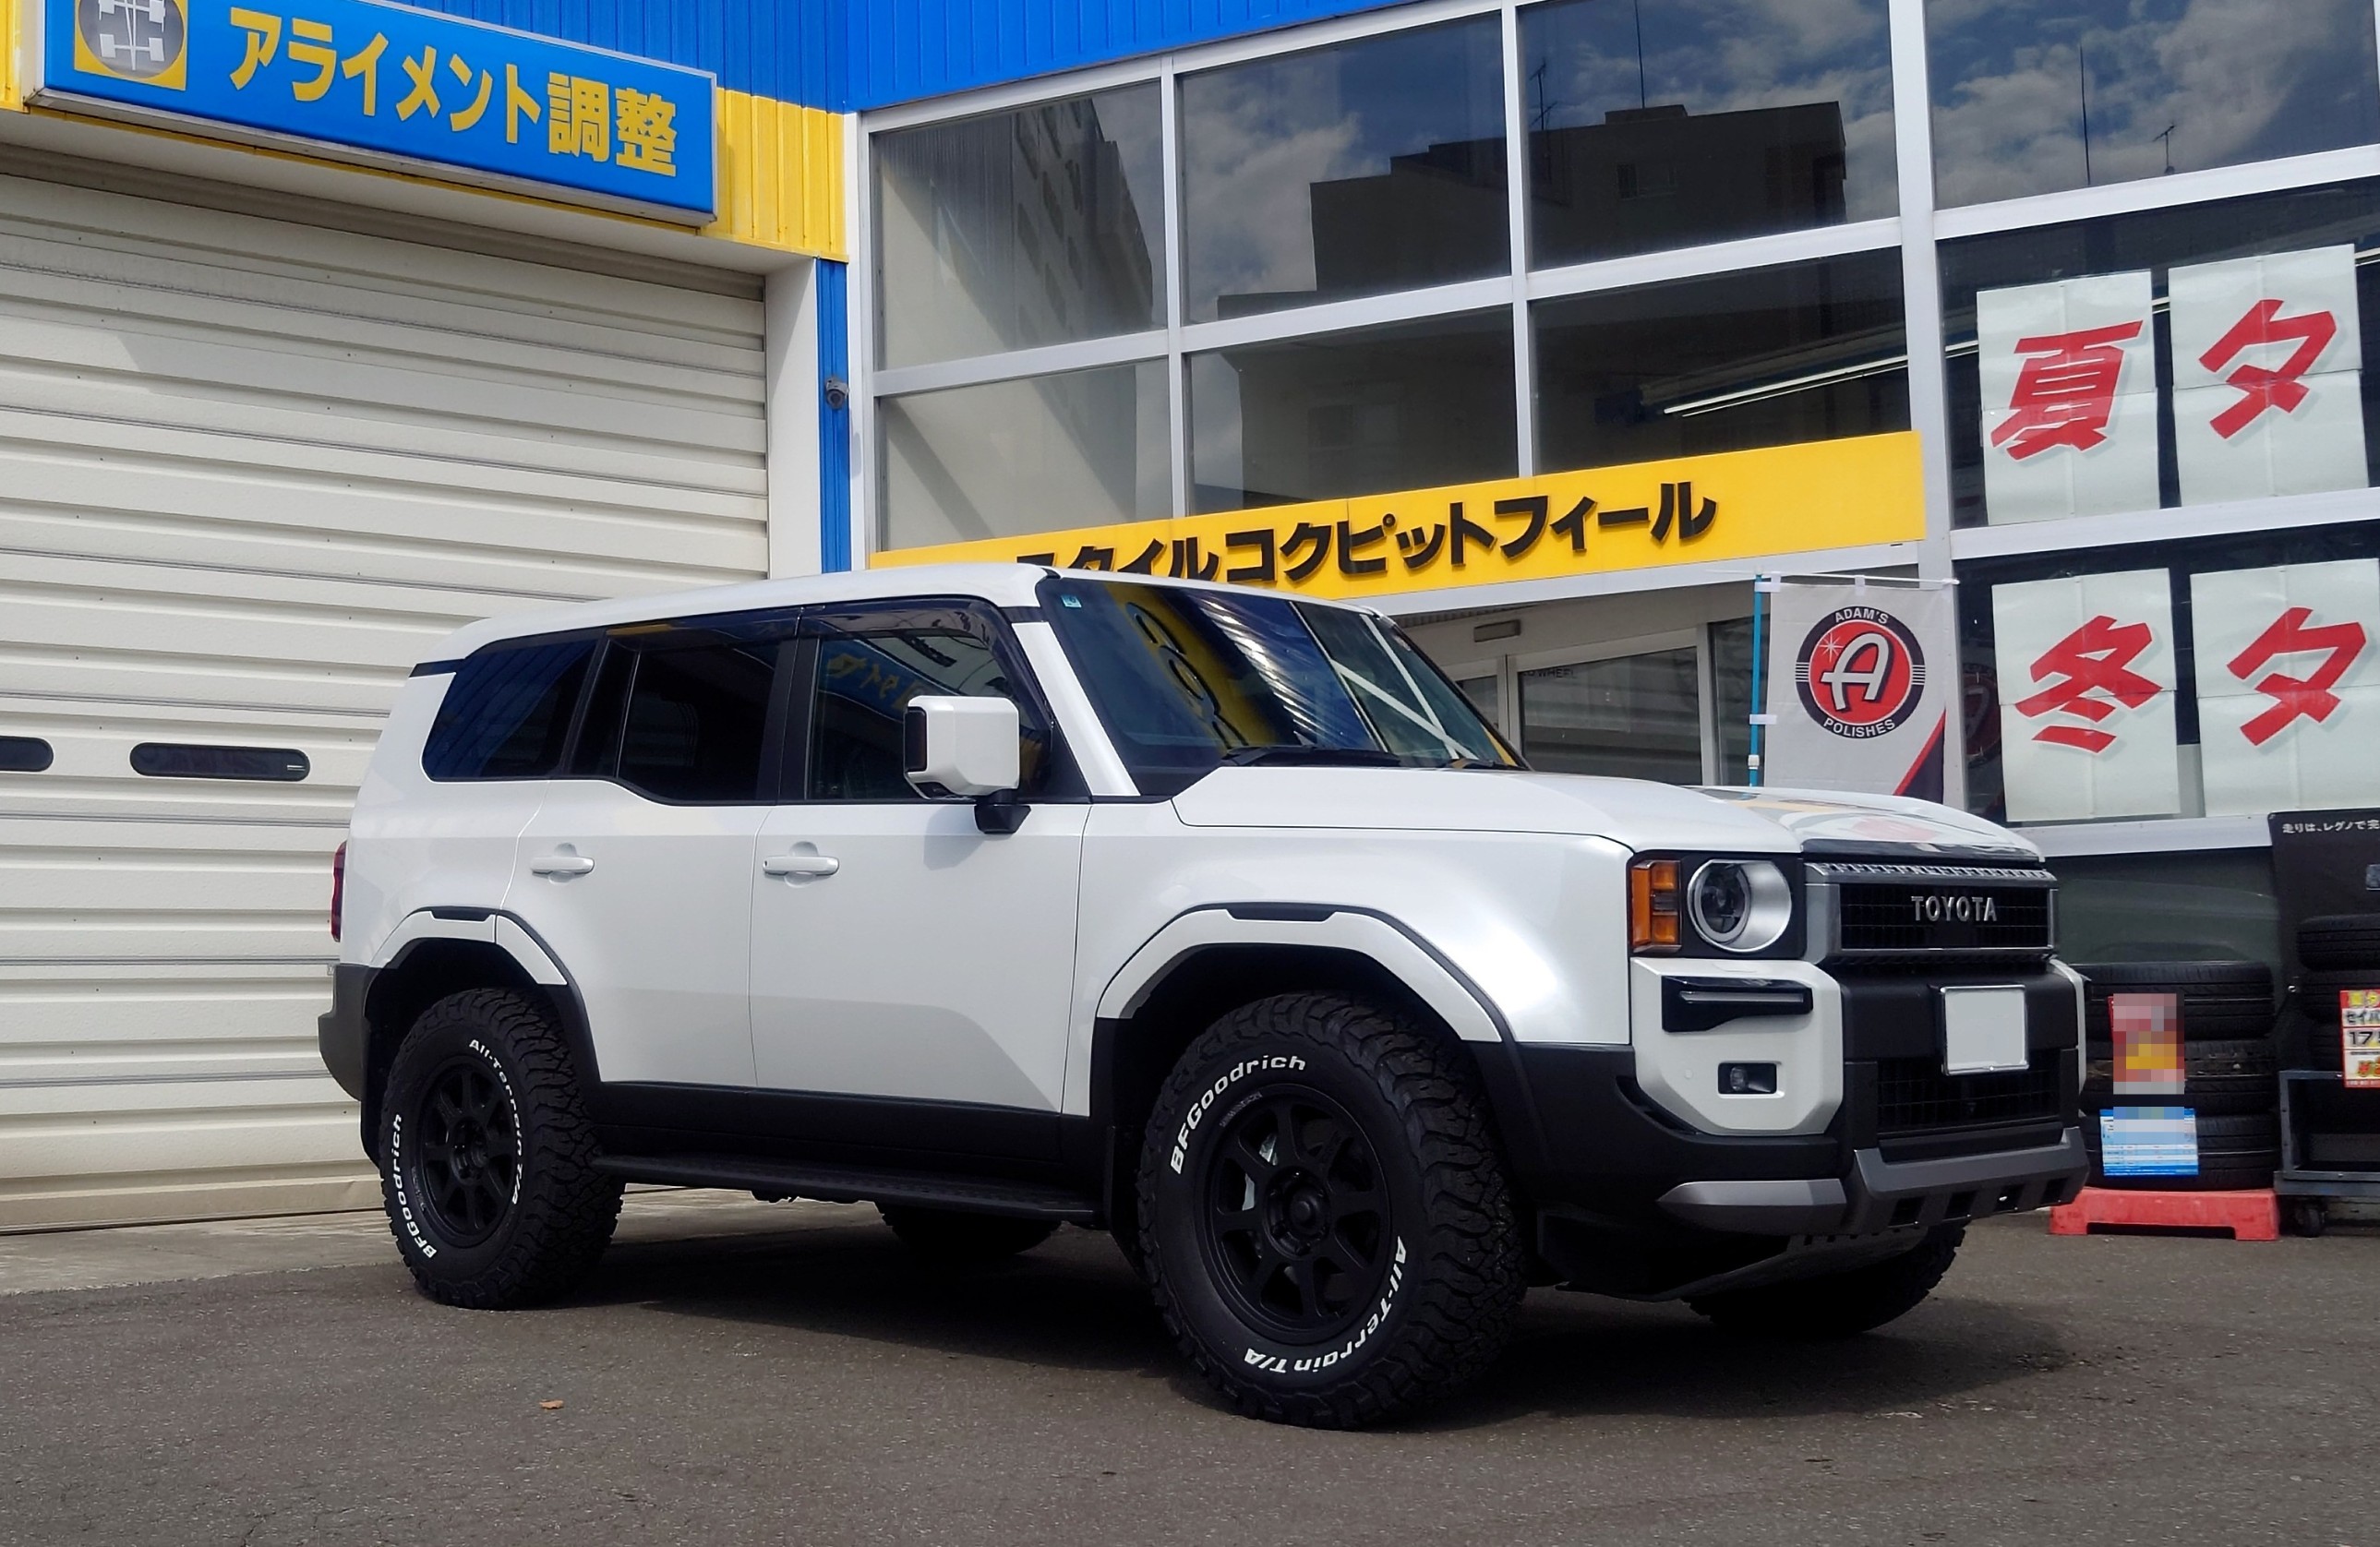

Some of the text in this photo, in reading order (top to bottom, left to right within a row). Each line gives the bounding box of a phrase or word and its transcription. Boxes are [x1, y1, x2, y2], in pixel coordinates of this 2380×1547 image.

[230, 7, 677, 176] アライメント調整
[1016, 481, 1716, 583] イルコクピットフィール
[1834, 607, 1889, 624] ADAM'S
[1823, 719, 1895, 738] POLISHES
[1910, 895, 1997, 922] TOYOTA
[2349, 1031, 2380, 1045] 17
[469, 1039, 523, 1157] All-Terrain
[1170, 1054, 1306, 1175] BFGoodrich
[391, 1113, 438, 1260] BFGoodrich
[1244, 1236, 1407, 1373] All-Terrain T/A
